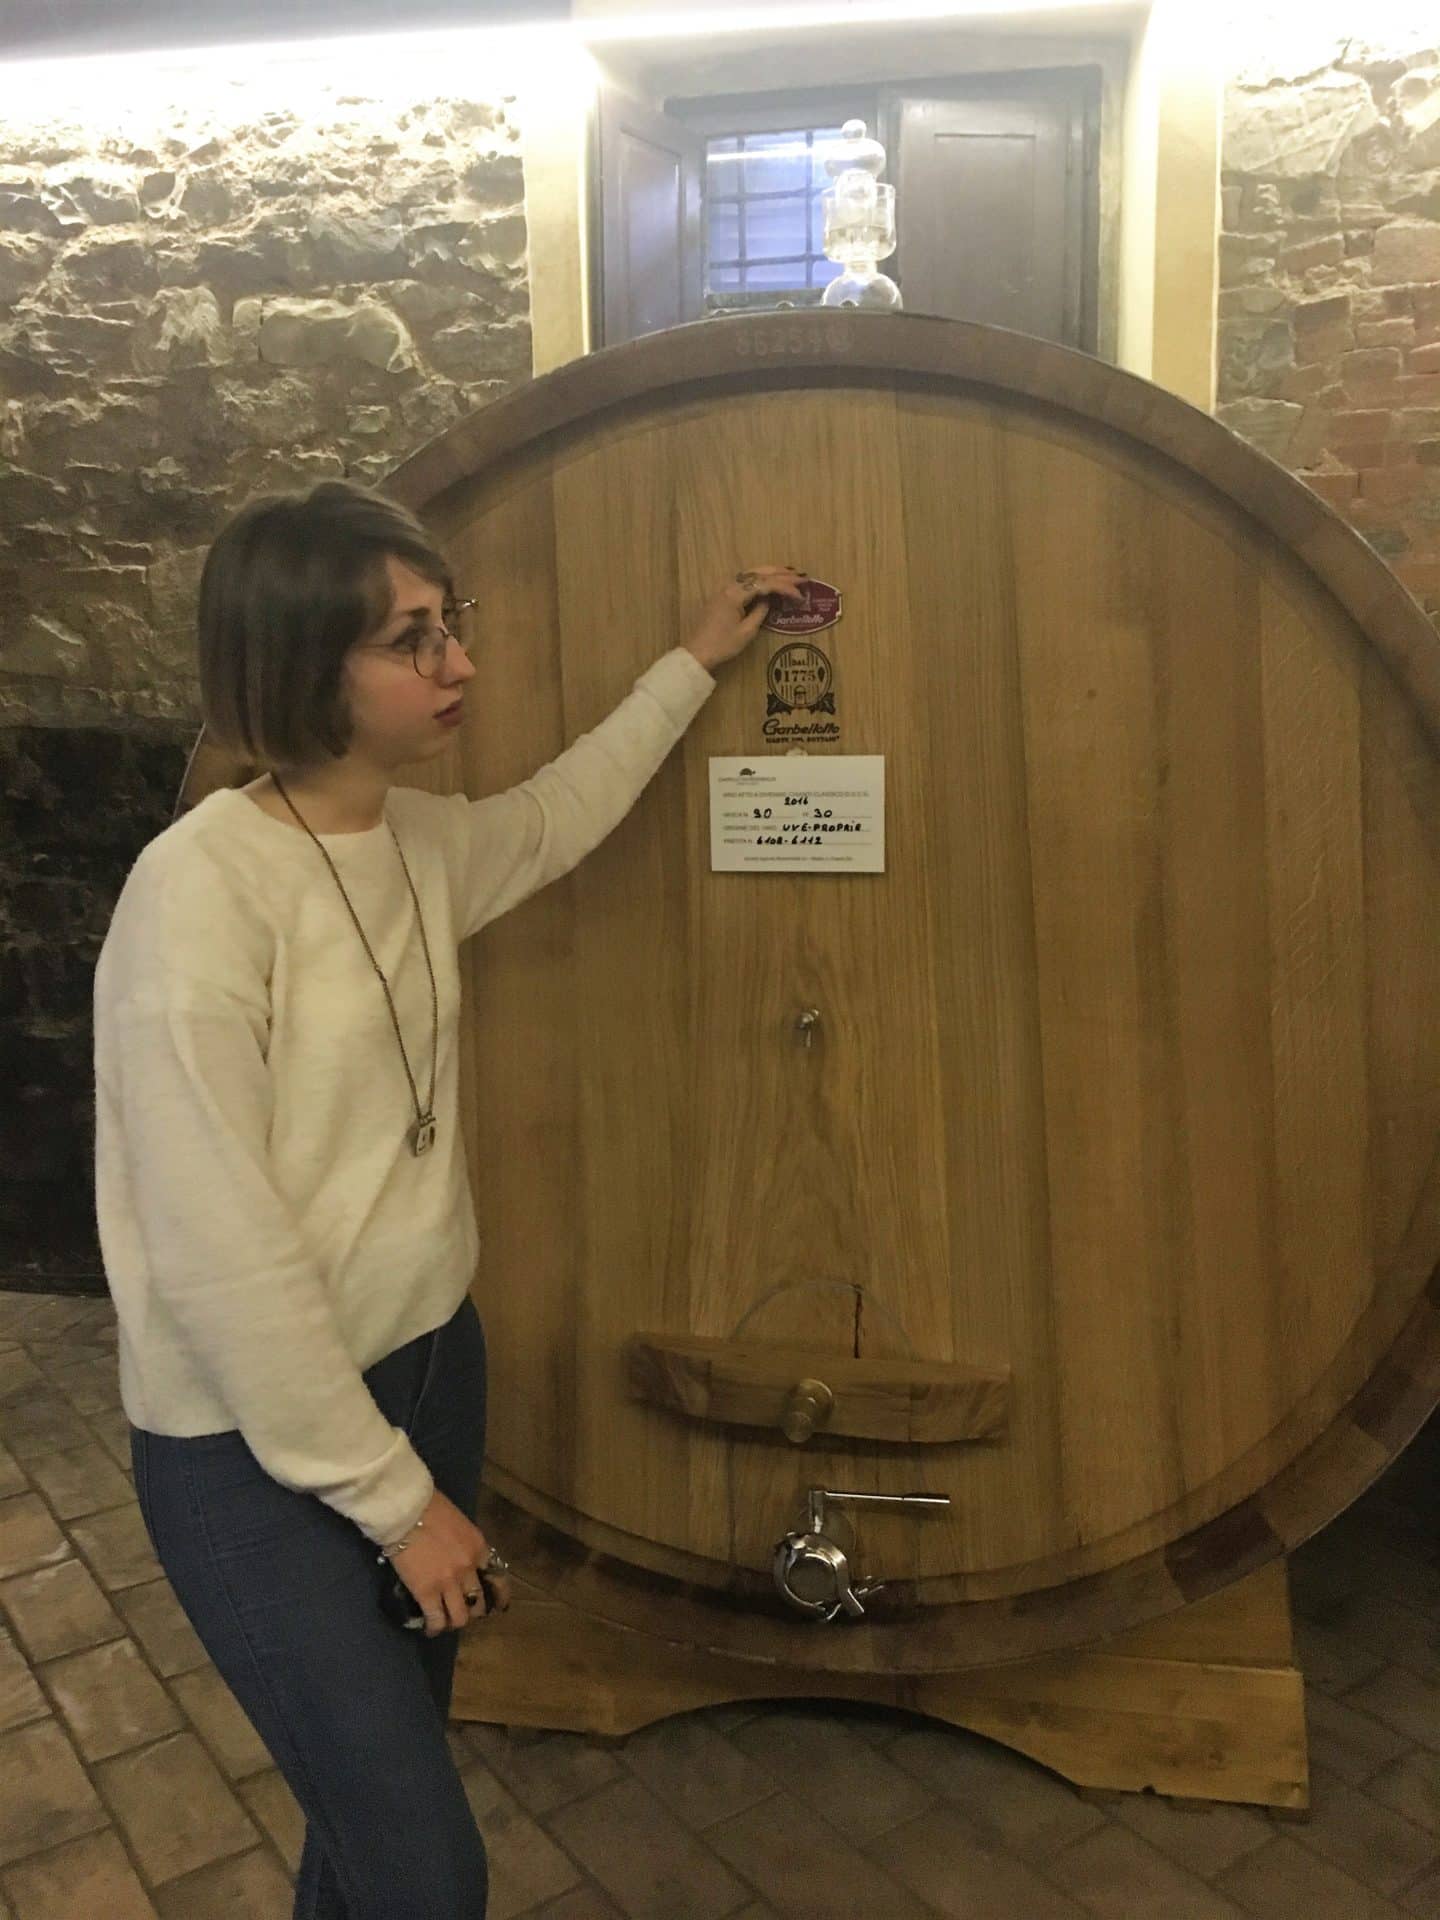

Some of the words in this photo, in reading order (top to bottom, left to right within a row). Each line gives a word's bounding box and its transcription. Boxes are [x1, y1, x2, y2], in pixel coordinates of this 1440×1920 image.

[784, 669, 816, 682] 1775
[784, 796, 809, 806] 2016
[813, 808, 833, 819] 30
